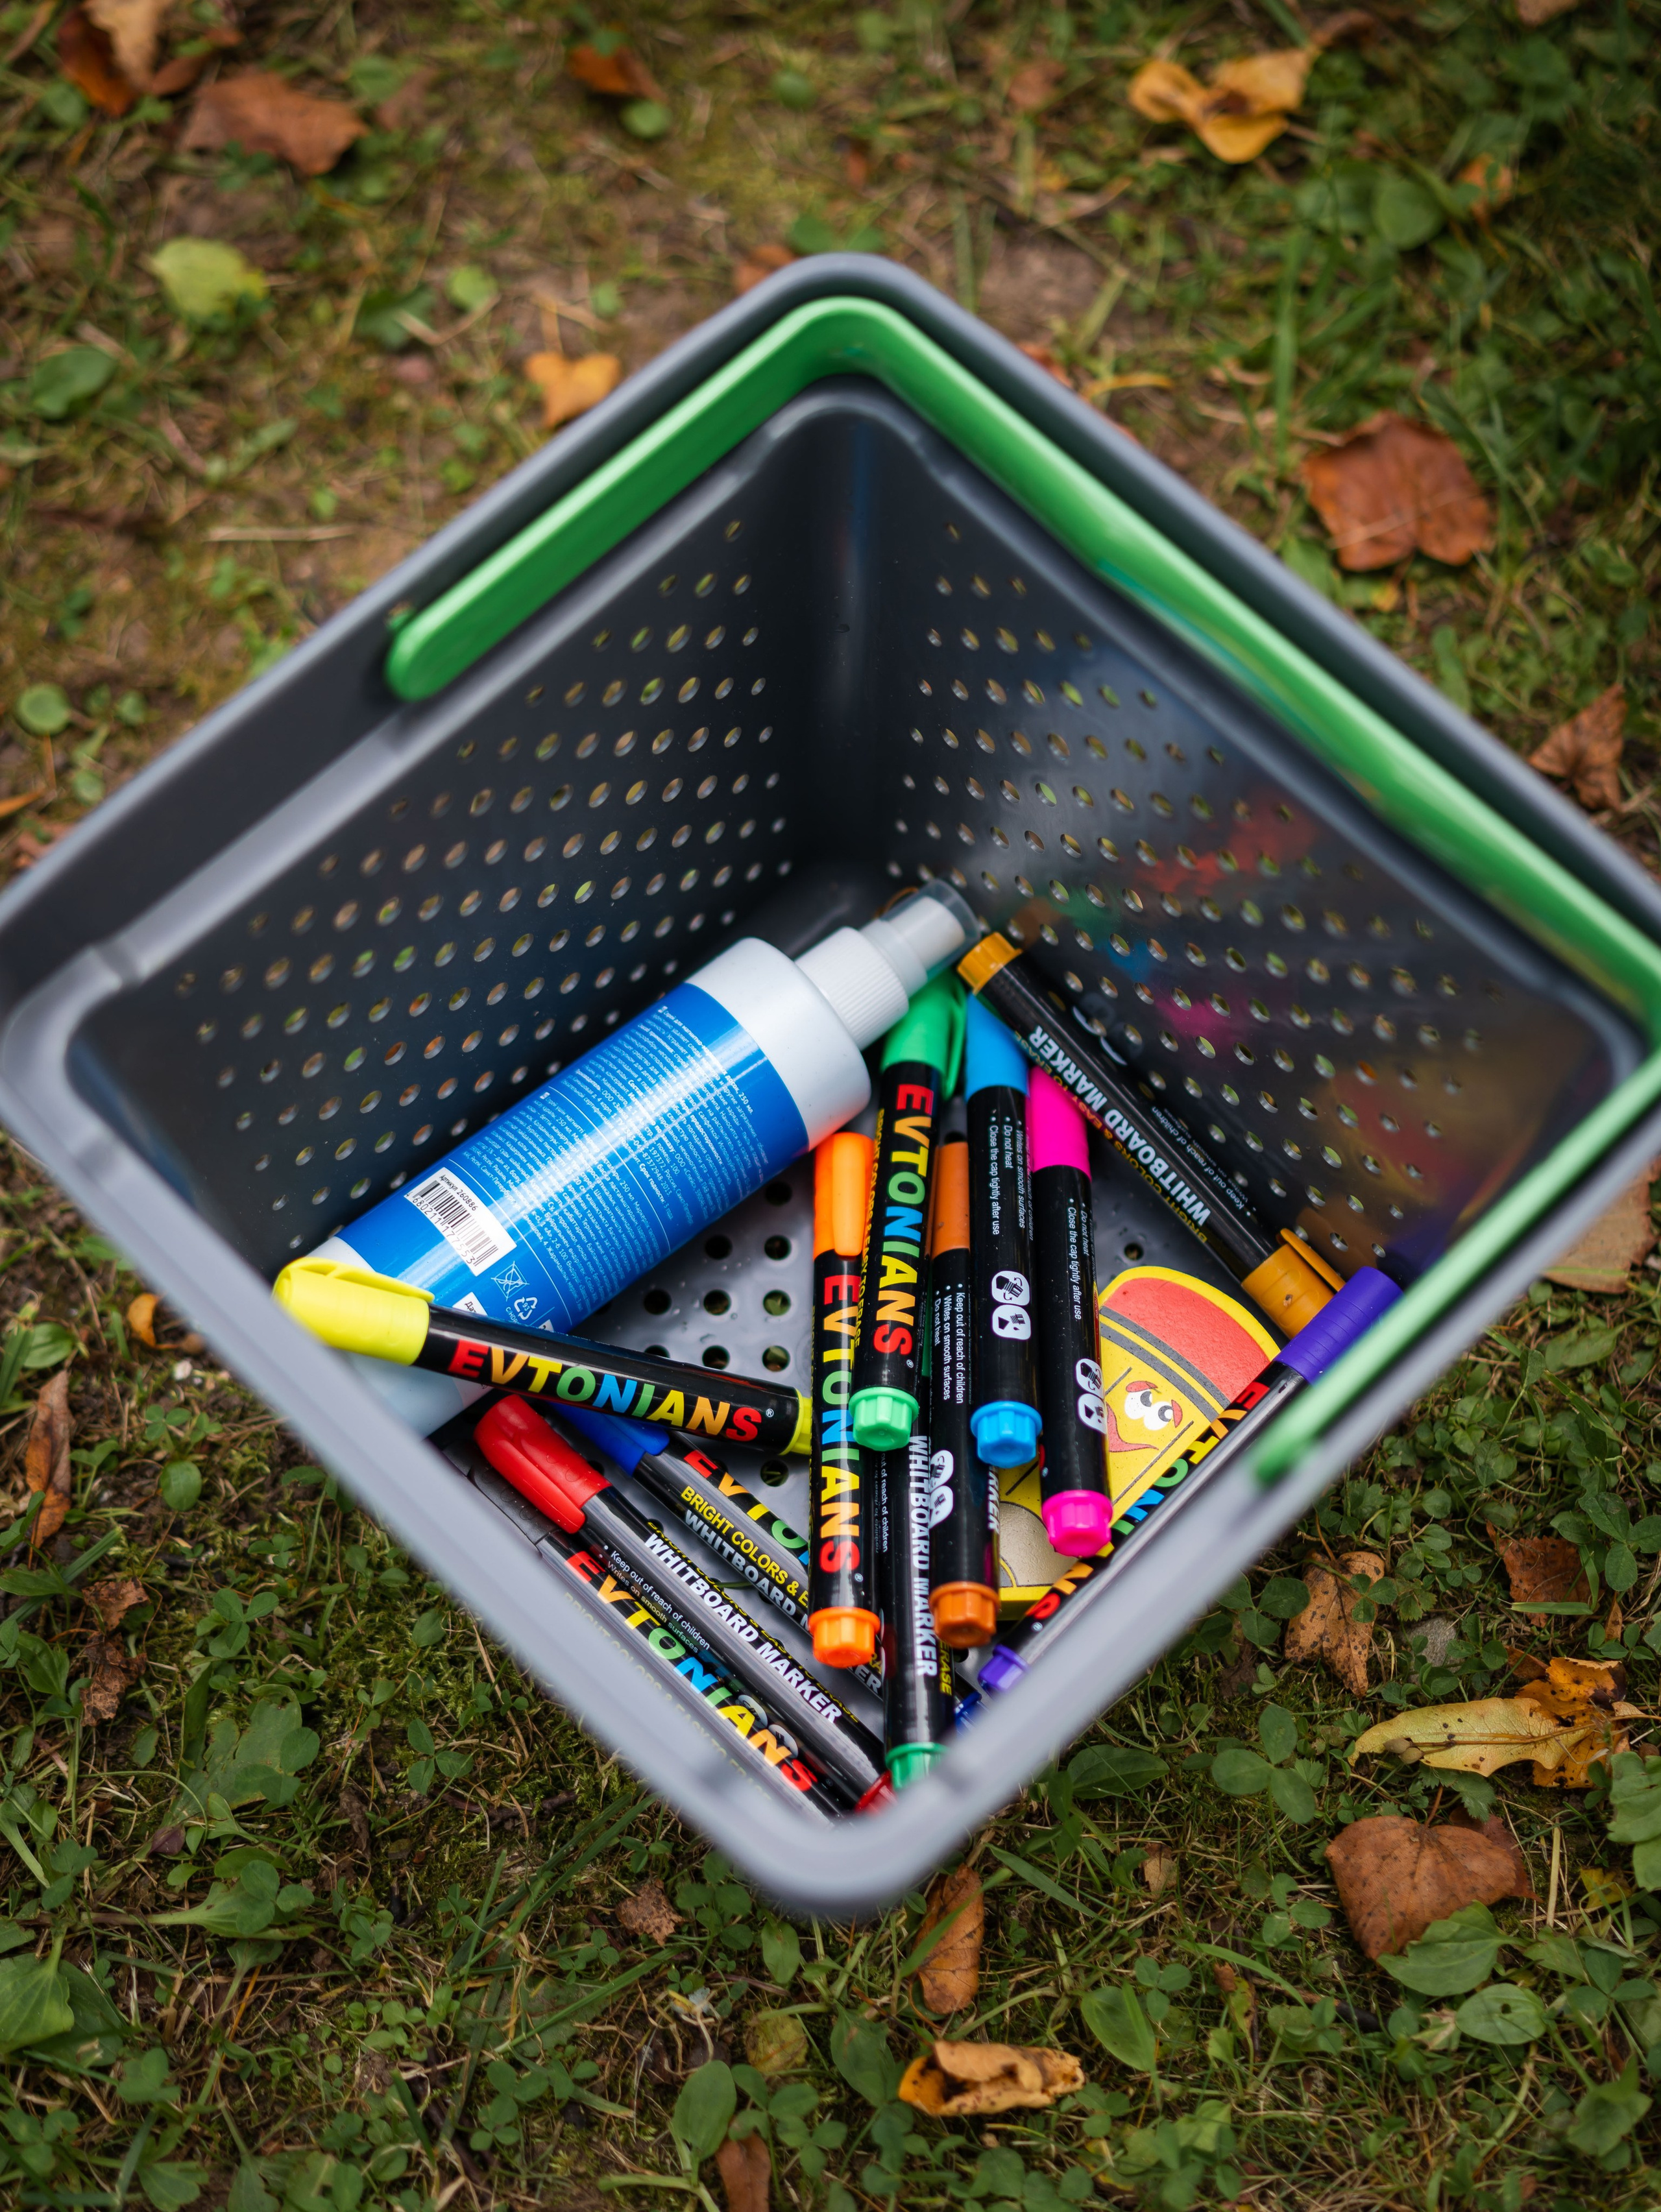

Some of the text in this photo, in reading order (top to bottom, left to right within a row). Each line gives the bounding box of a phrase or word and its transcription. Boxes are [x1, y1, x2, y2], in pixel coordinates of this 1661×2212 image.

[1026, 1024, 1108, 1112] MARKER
[989, 1125, 999, 1146] Close
[1004, 1124, 1013, 1168] Do not heat
[990, 1148, 999, 1160] the
[1017, 1155, 1022, 1164] on
[1150, 1105, 1245, 1209] Keep out of reach of children
[989, 1162, 997, 1175] cap
[1102, 1106, 1213, 1225] WHITBOARD
[989, 1177, 1000, 1199] tightly
[1017, 1166, 1025, 1194] smooth
[457, 1189, 478, 1211] 260886
[991, 1201, 1000, 1218] after
[1068, 1207, 1076, 1229] Close
[1080, 1210, 1087, 1222] Do
[413, 1197, 442, 1224] 680211
[443, 1226, 476, 1264] 177553
[1068, 1244, 1077, 1259] cap
[1069, 1260, 1080, 1284] tightly
[934, 1298, 941, 1311] Do
[954, 1292, 965, 1312] Keep
[1073, 1284, 1082, 1303] after
[522, 1303, 529, 1311] 93
[956, 1314, 964, 1326] out
[956, 1328, 965, 1336] of
[943, 1295, 952, 1399] Writes on smooth surfaces
[956, 1338, 965, 1360] reach
[955, 1372, 965, 1403] children
[880, 1469, 887, 1478] of
[882, 1506, 888, 1515] of
[986, 1465, 1000, 1534] RKER
[679, 1485, 734, 1536] BRIGHT
[729, 1529, 790, 1585] COLORS
[784, 1579, 802, 1596] &
[679, 1509, 800, 1617] WHITBOARD
[908, 1435, 937, 1676] WHITBOARD MARKER
[605, 1561, 699, 1653] Writes on smooth surfaces
[609, 1550, 712, 1650] Keep out of reach of children
[643, 1532, 760, 1645] WHITBOARD
[755, 1639, 844, 1724] MARKER
[939, 1641, 952, 1696] ERASE
